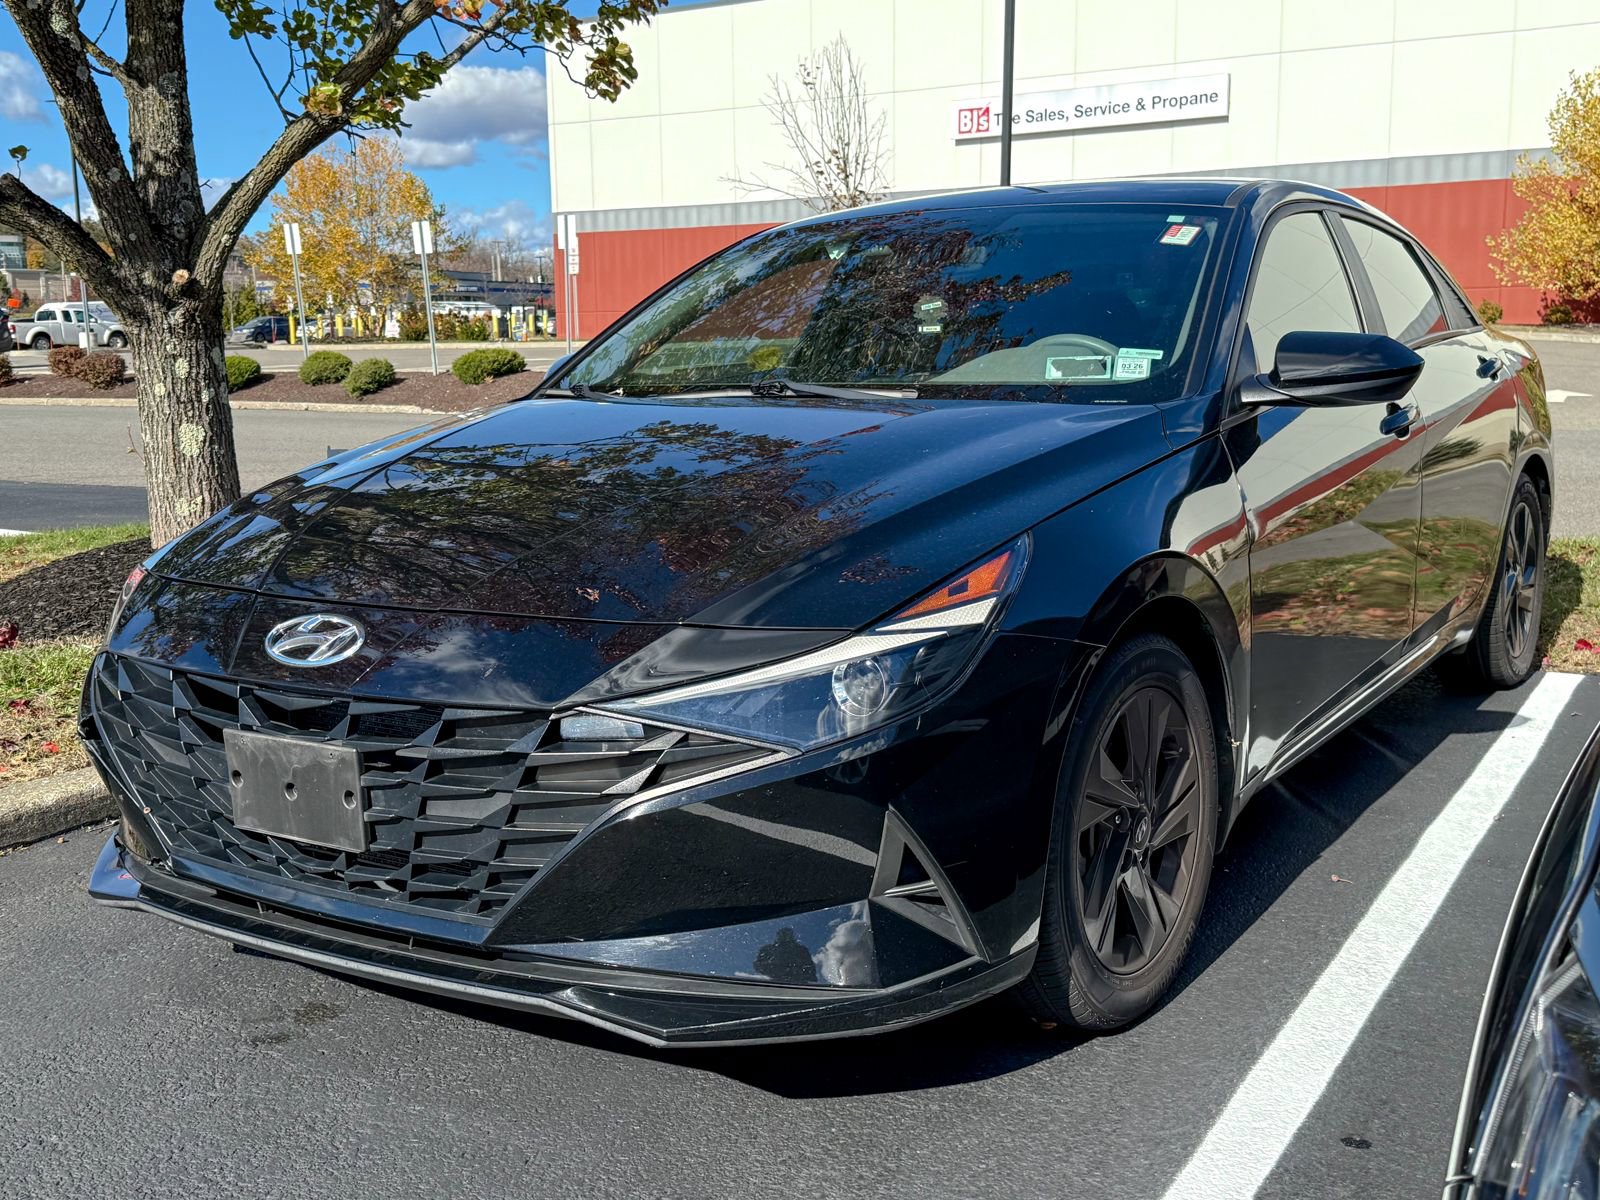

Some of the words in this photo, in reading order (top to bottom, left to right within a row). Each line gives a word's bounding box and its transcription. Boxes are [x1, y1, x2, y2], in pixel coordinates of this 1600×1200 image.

[994, 112, 1021, 126] Te
[1025, 108, 1069, 123] Sales,
[1074, 101, 1131, 118] Service
[1135, 97, 1146, 112] &
[1151, 91, 1219, 110] Propane
